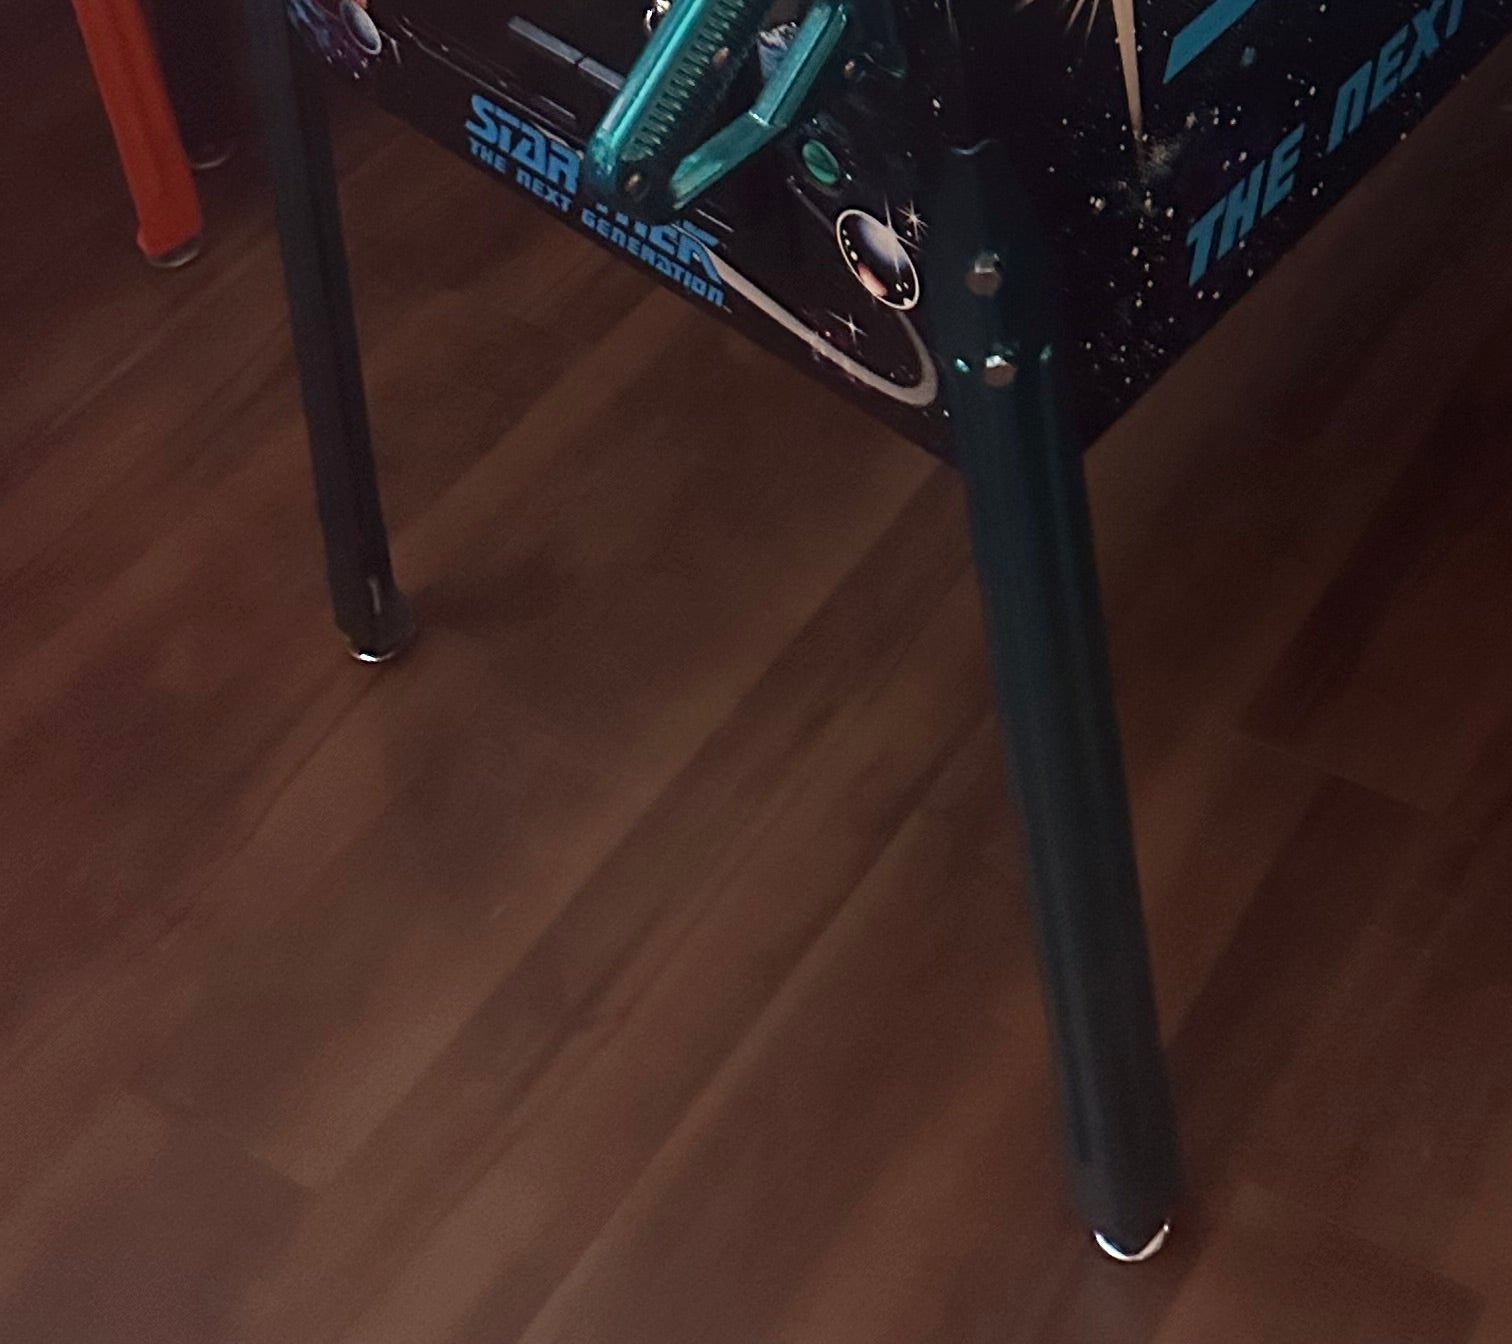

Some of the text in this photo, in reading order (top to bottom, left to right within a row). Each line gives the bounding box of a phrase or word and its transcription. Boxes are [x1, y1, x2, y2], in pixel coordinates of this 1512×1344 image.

[464, 93, 580, 195] STAR
[468, 135, 725, 307] THE NEXT GENERATION
[1186, 123, 1305, 289] THE
